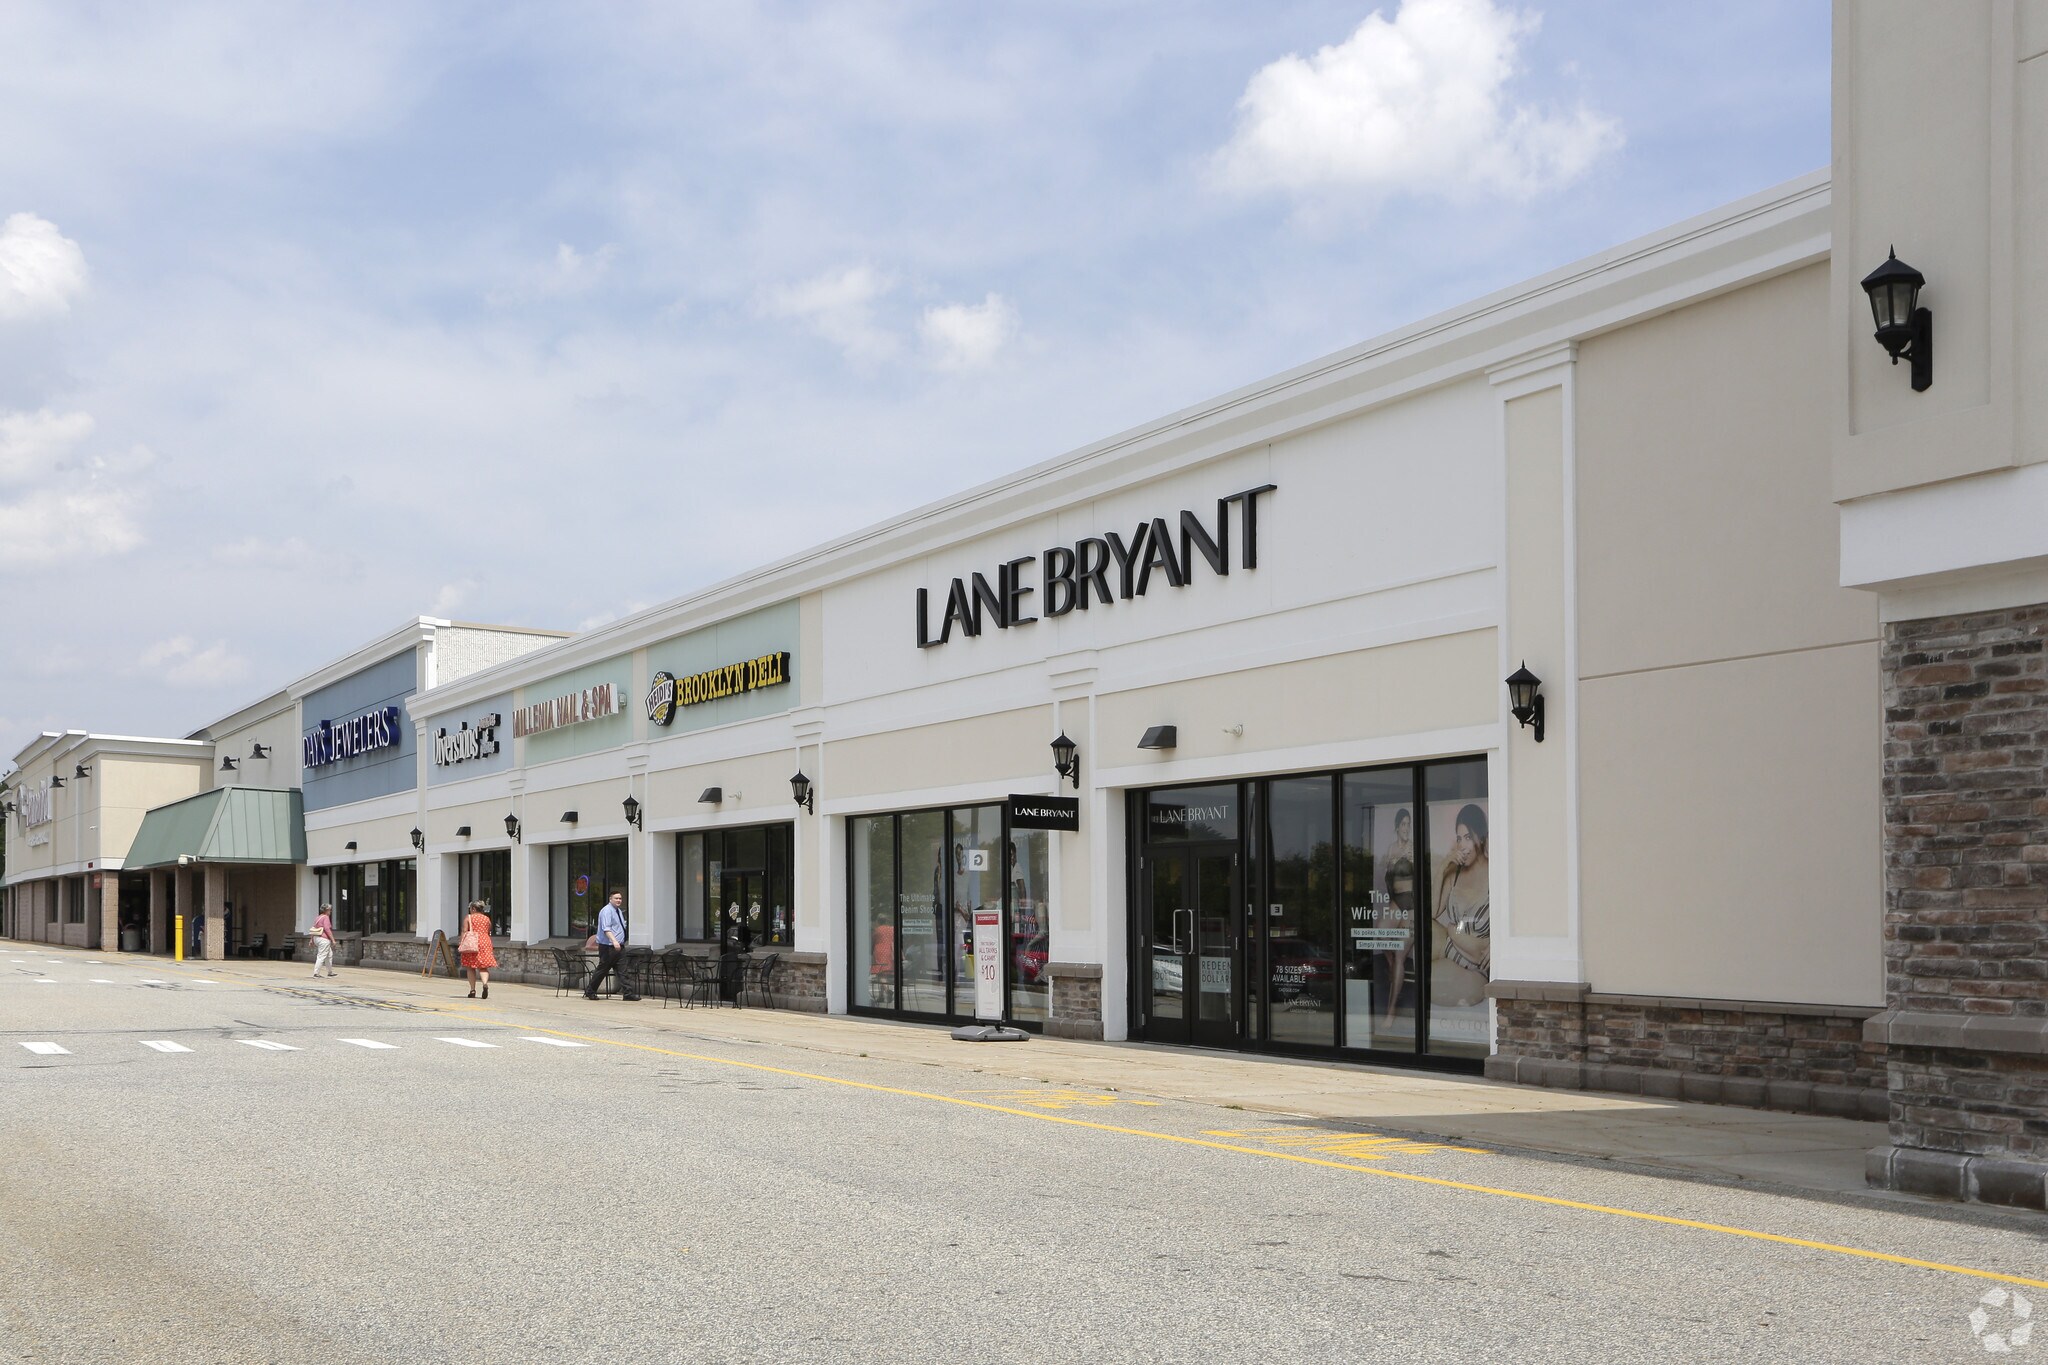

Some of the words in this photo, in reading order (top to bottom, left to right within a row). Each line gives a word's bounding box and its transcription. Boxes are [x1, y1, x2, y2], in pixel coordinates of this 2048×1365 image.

[916, 556, 1038, 649] LANE
[1043, 484, 1277, 618] BRYANT
[675, 661, 745, 707] BROOKLYN
[747, 651, 784, 690] DELI
[648, 683, 672, 712] HEIDI'S
[512, 699, 554, 738] MILLENIA
[556, 692, 580, 727] NAIL
[581, 689, 589, 720] &
[591, 683, 612, 718] SPA
[303, 723, 328, 768] DAY'S
[330, 707, 393, 761] JEWELERS
[432, 722, 480, 766] Diversions
[1015, 807, 1039, 817] LANE
[1040, 808, 1075, 818] BRYANT
[1160, 808, 1187, 823] LANE
[1188, 805, 1229, 821] BRYANT
[900, 893, 910, 902] The
[1368, 890, 1390, 903] The
[901, 904, 919, 914] Denim
[1351, 906, 1378, 920] Wire
[1383, 906, 1408, 920] Free
[981, 965, 996, 980] $10
[1275, 965, 1284, 974] 78
[1284, 965, 1302, 974] SIZES
[1272, 974, 1306, 983] AVAILABLE
